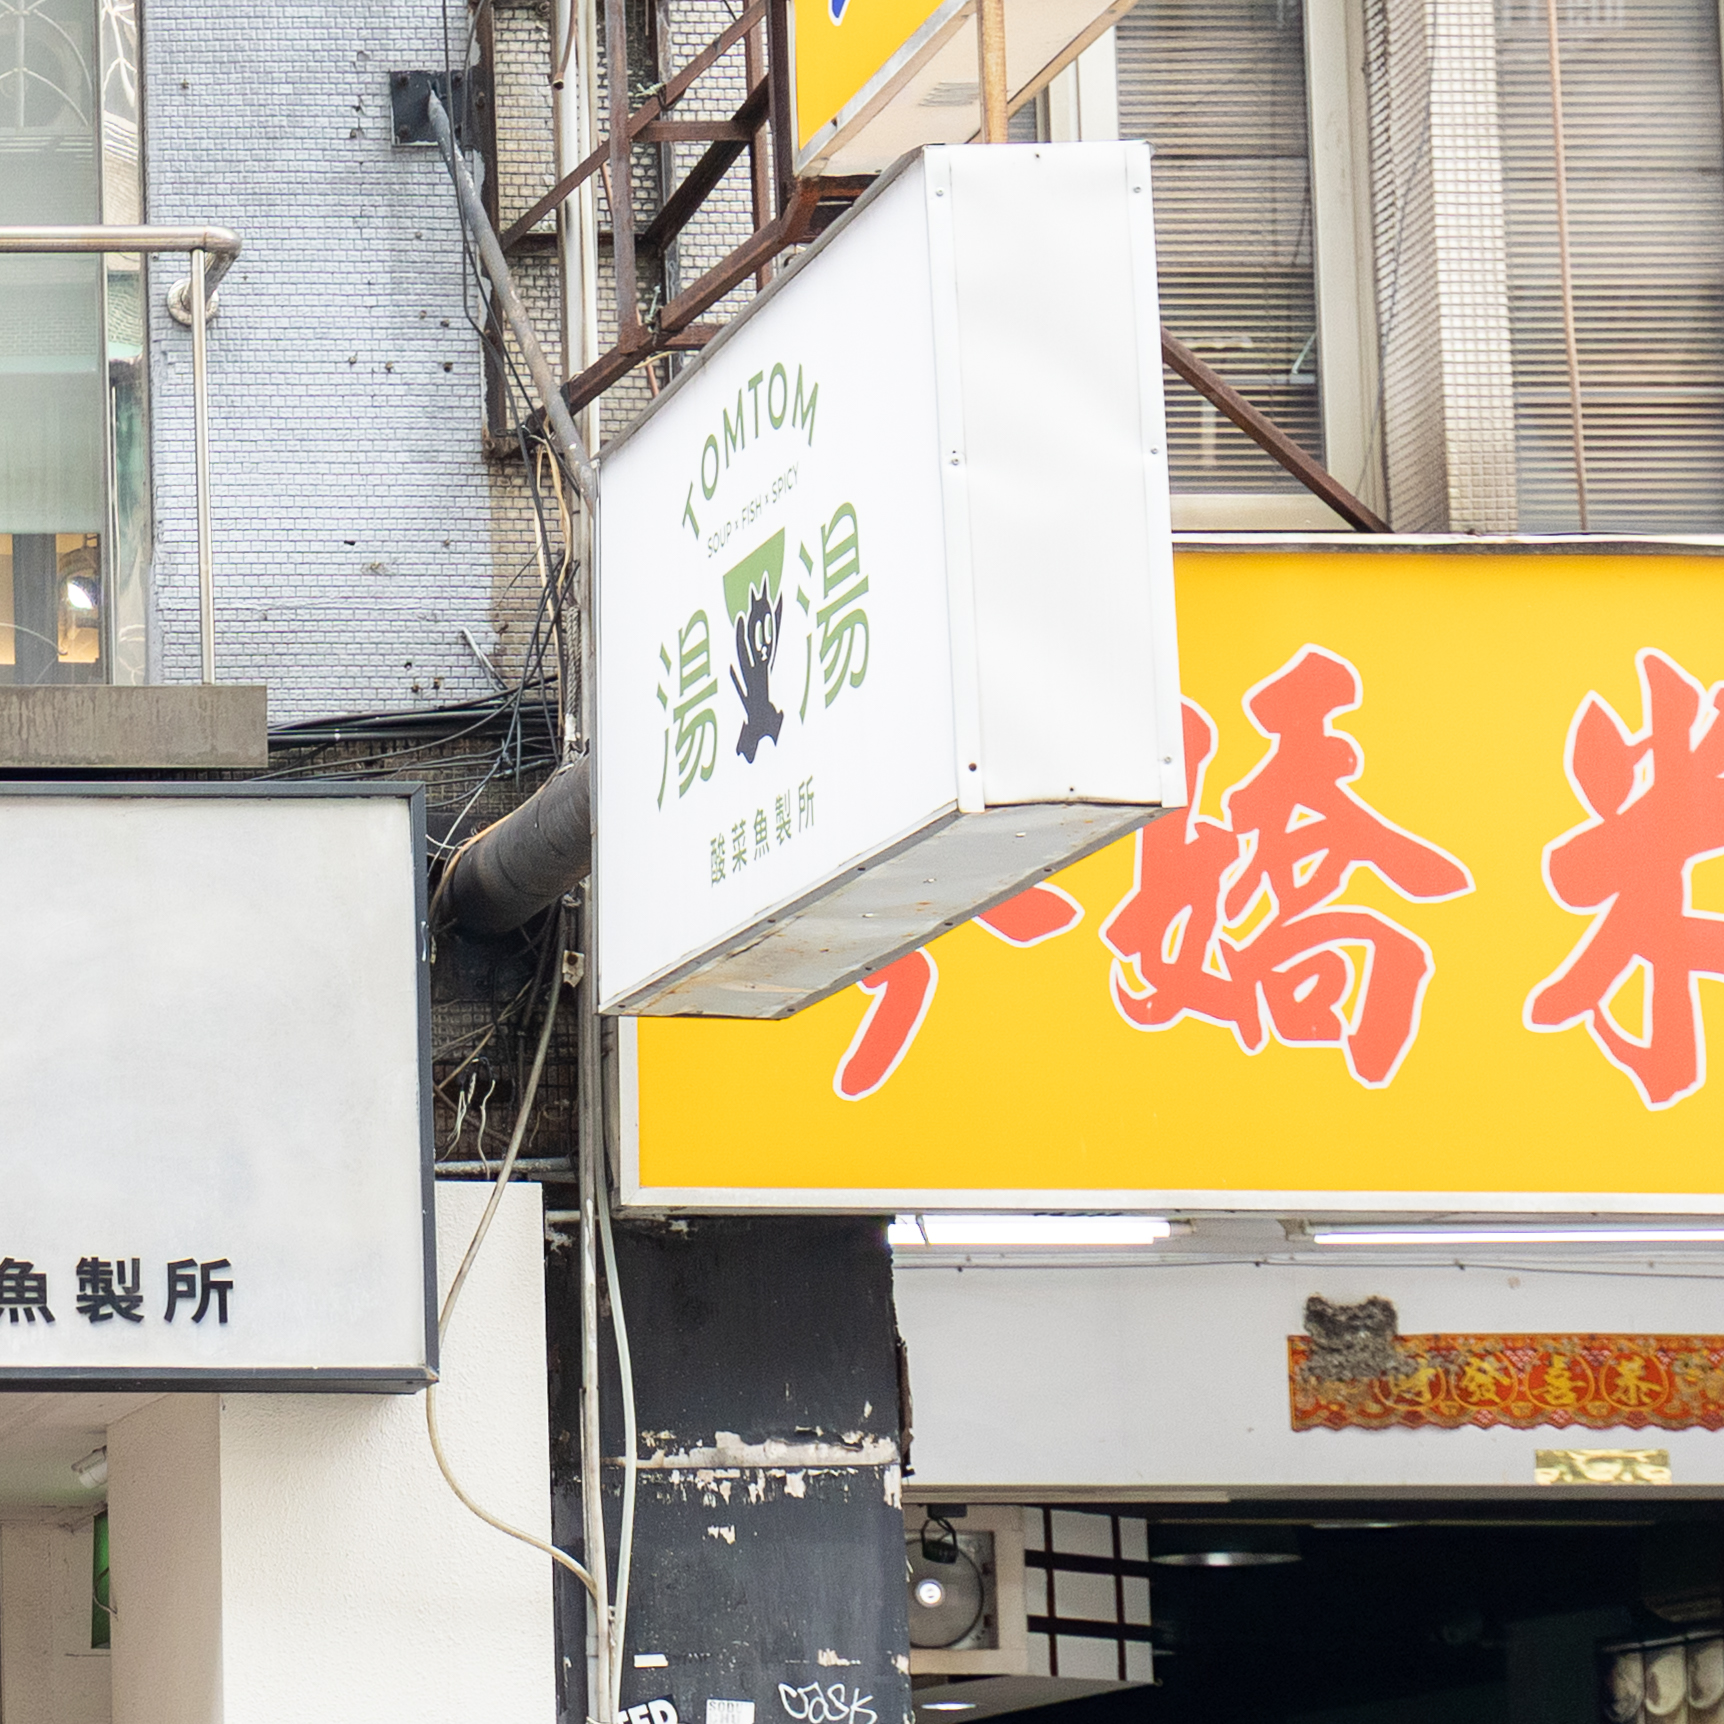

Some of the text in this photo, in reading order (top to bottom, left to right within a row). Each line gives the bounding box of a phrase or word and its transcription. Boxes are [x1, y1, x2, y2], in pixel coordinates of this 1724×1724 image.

[682, 362, 819, 541] TOMTOM
[707, 521, 732, 558] SOUP
[742, 494, 763, 530] FISH
[772, 461, 800, 504] SPICY
[709, 774, 816, 889] 酸菜魚製所
